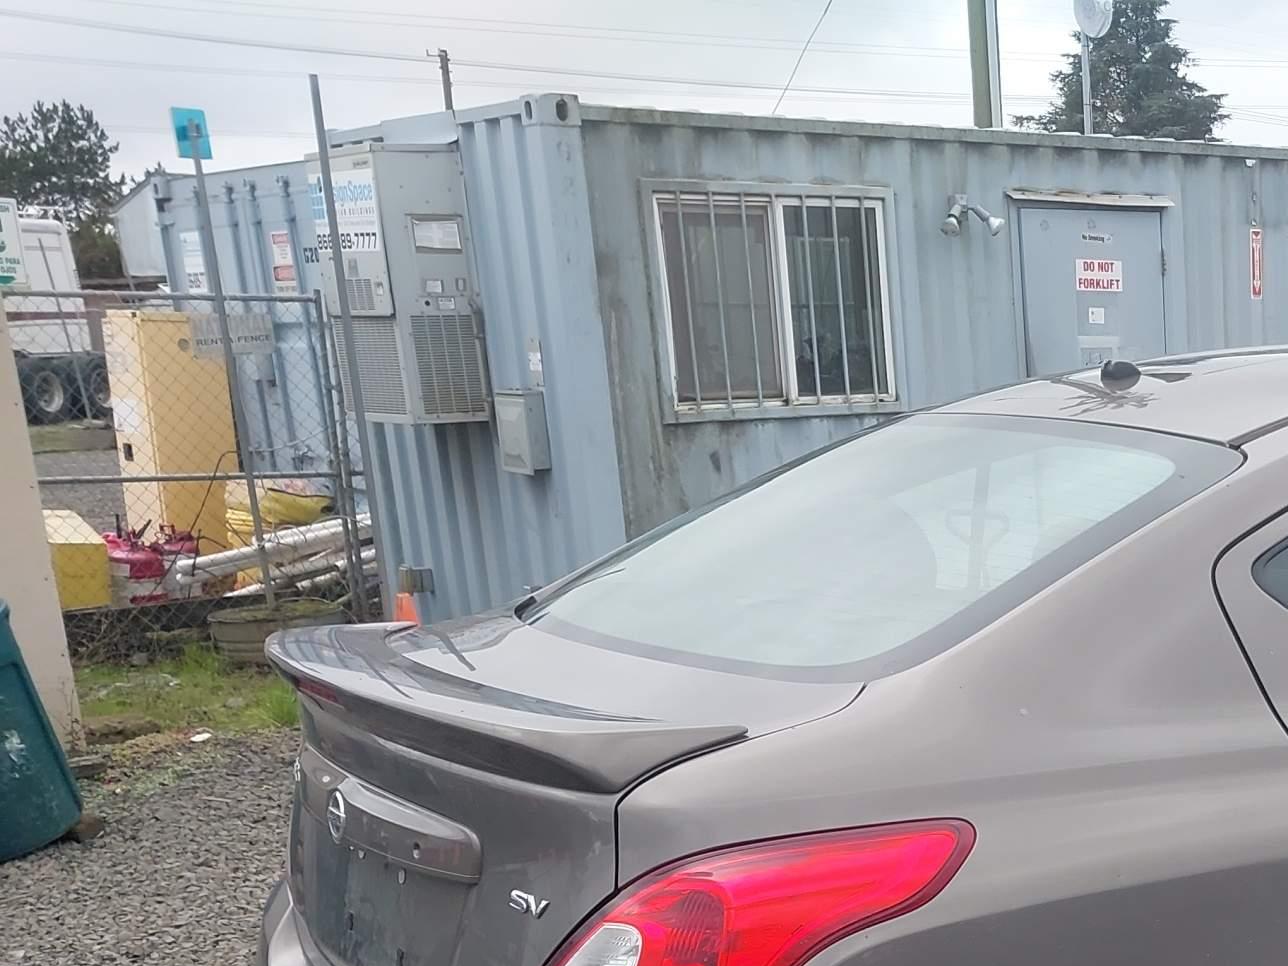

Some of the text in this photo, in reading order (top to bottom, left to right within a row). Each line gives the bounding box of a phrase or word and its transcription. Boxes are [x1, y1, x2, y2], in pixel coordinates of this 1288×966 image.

[1083, 261, 1115, 273] DO NOT
[1078, 278, 1121, 290] FORKLIFT
[508, 888, 551, 920] SV
